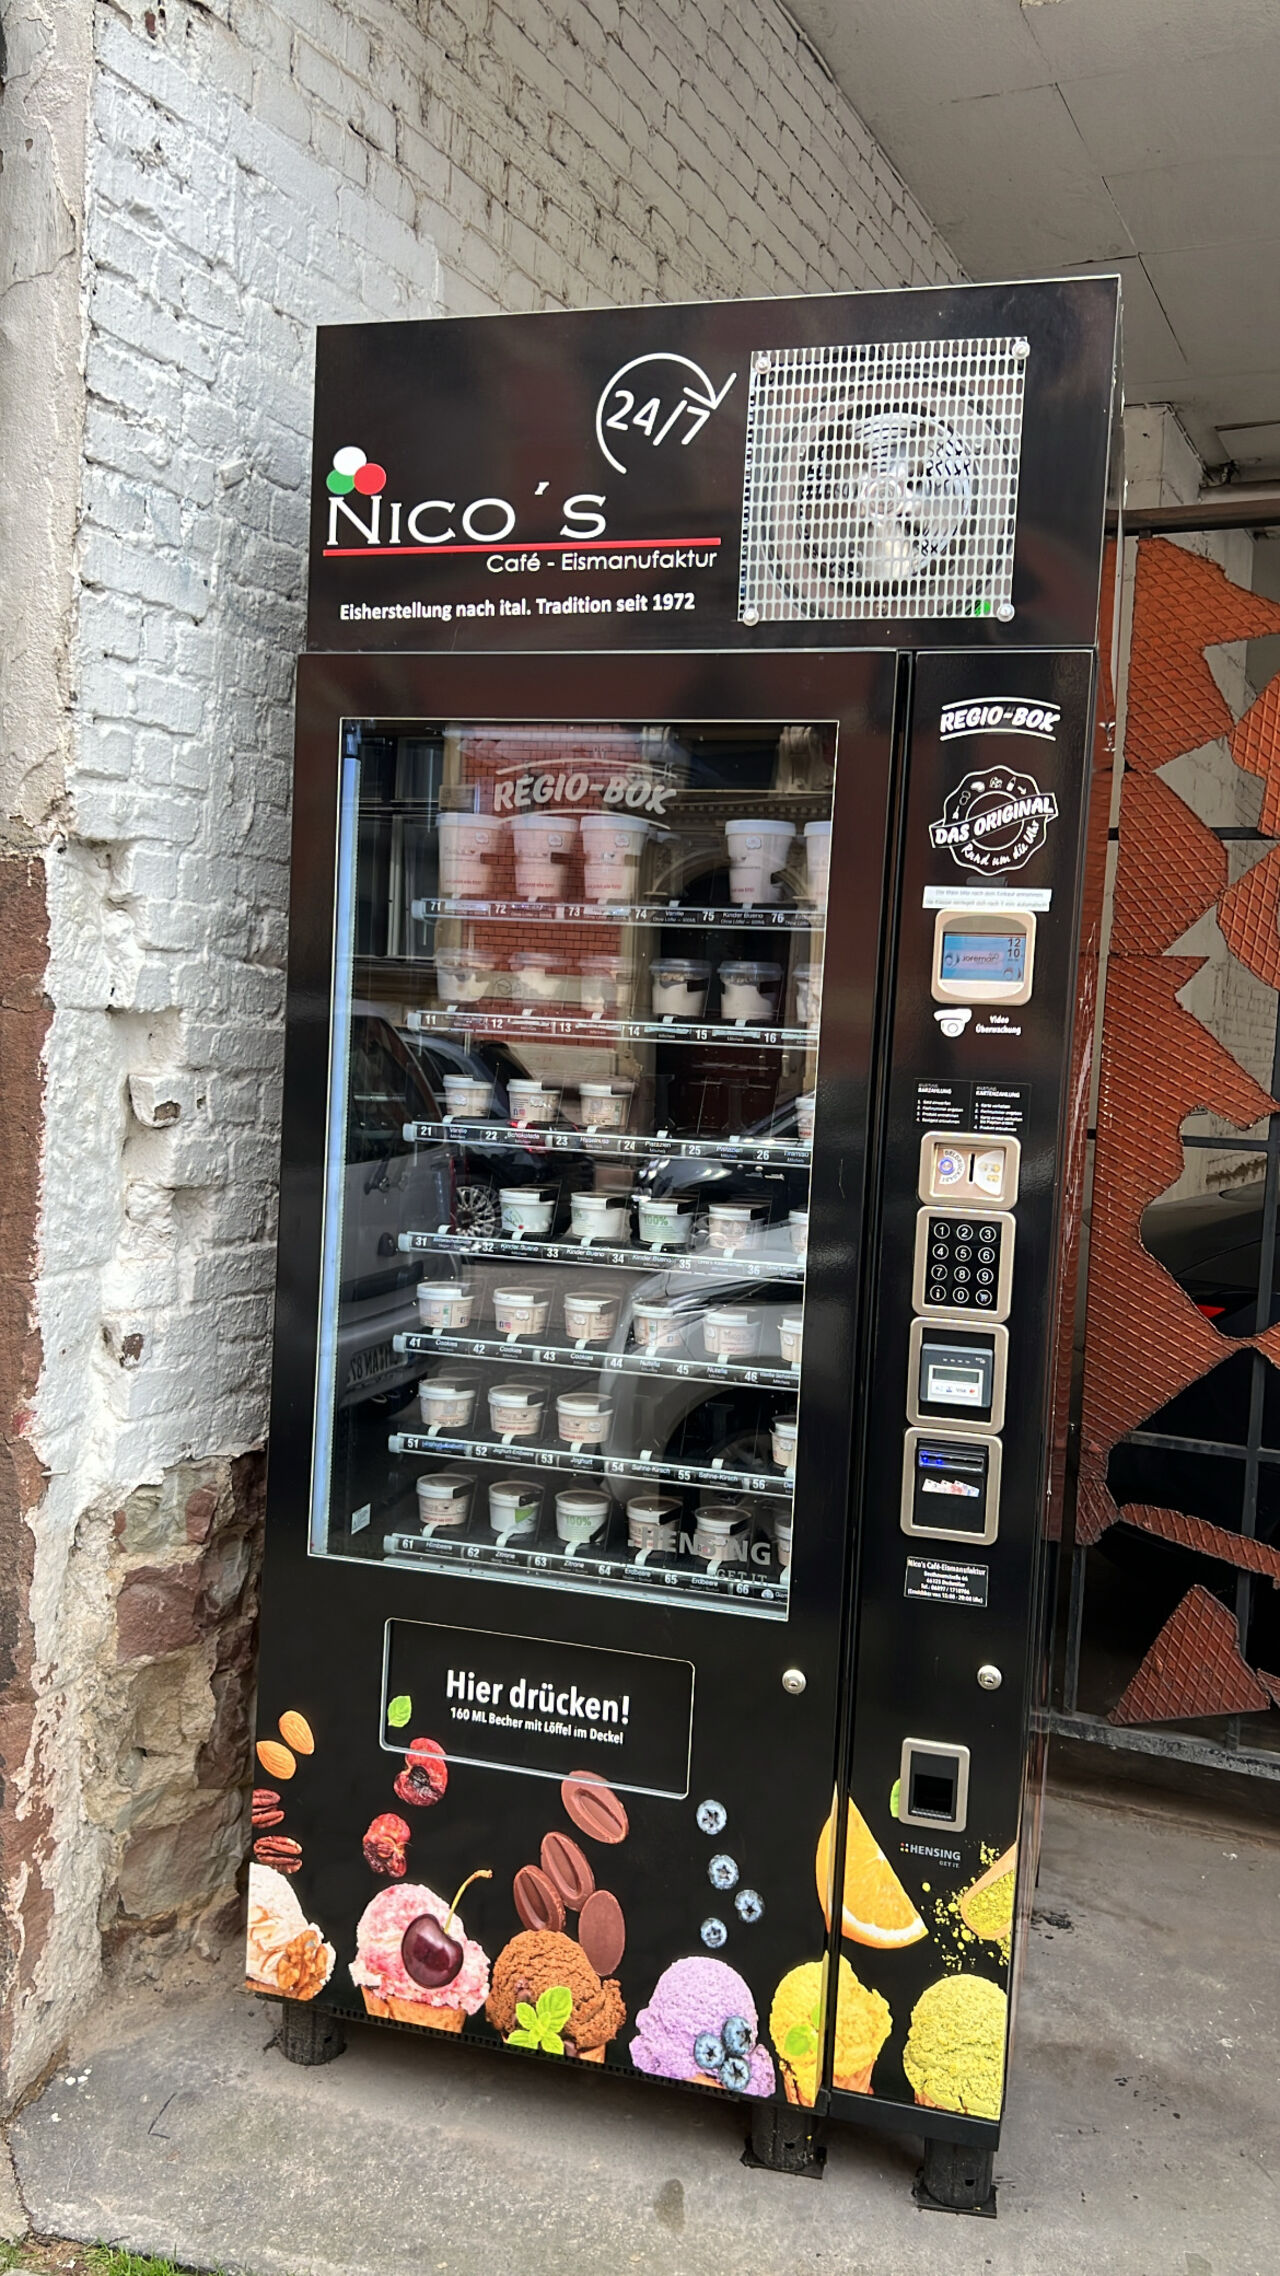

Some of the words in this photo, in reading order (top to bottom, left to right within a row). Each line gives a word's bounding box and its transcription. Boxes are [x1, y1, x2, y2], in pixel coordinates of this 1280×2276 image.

[606, 390, 710, 445] 24/7
[487, 553, 541, 573] Café
[561, 550, 717, 571] Eismanufaktur
[340, 602, 452, 622] Eisherstellung
[456, 600, 495, 617] nach
[500, 598, 532, 616] ital.
[536, 596, 612, 615] Tradition
[616, 594, 648, 612] seit
[652, 592, 695, 611] 1972
[935, 824, 970, 844] DAS
[974, 797, 1054, 836] ORIGINAL
[961, 843, 990, 866] Rund
[992, 856, 1011, 866] um
[1013, 843, 1028, 859] die
[1023, 820, 1040, 844] Uhr
[431, 902, 442, 911] 71
[495, 904, 506, 914] 72
[569, 907, 580, 917] 73
[636, 909, 647, 920] 74
[703, 911, 715, 922] 75
[772, 913, 784, 924] 76
[1008, 939, 1021, 947] 12
[1008, 949, 1020, 958] 10
[425, 1015, 436, 1025] 11
[492, 1019, 503, 1029] 12
[990, 1016, 1010, 1024] Video
[560, 1023, 572, 1033] 13
[628, 1026, 640, 1037] 14
[976, 1024, 1022, 1035] Überwachung
[696, 1030, 708, 1040] 15
[764, 1032, 777, 1043] 16
[421, 1126, 432, 1136] 21
[486, 1131, 498, 1141] 22
[556, 1136, 568, 1146] 23
[624, 1141, 636, 1150] 24
[689, 1145, 701, 1156] 25
[757, 1150, 770, 1161] 26
[644, 1214, 668, 1226] 100%
[940, 1226, 944, 1236] 1
[962, 1228, 968, 1238] 2
[984, 1230, 991, 1240] 3
[416, 1237, 427, 1247] 31
[483, 1242, 494, 1252] 32
[547, 1248, 559, 1258] 33
[937, 1247, 944, 1256] 4
[960, 1249, 967, 1258] 5
[983, 1251, 990, 1260] 6
[612, 1254, 624, 1264] 34
[679, 1259, 691, 1269] 35
[748, 1265, 760, 1276] 36
[936, 1268, 943, 1277] 7
[959, 1270, 966, 1279] 8
[982, 1272, 988, 1281] 9
[958, 1291, 964, 1300] 0
[409, 1338, 421, 1348] 41
[473, 1344, 485, 1354] 42
[500, 1346, 522, 1354] Cookies
[543, 1351, 556, 1361] 43
[570, 1353, 594, 1361] Cookies
[610, 1358, 623, 1368] 44
[677, 1365, 689, 1375] 45
[745, 1371, 758, 1382] 46
[408, 1439, 419, 1449] 51
[476, 1446, 488, 1456] 52
[541, 1454, 553, 1464] 53
[570, 1457, 593, 1465] Joghurt
[612, 1463, 624, 1472] 54
[632, 1464, 671, 1474] Sahne-Kirsch
[678, 1470, 691, 1480] 55
[699, 1472, 738, 1482] Sahne-Kirsch
[753, 1479, 766, 1489] 56
[566, 1516, 591, 1526] 100%
[402, 1539, 414, 1549] 61
[468, 1548, 480, 1558] 62
[535, 1556, 547, 1566] 63
[564, 1560, 585, 1569] Zitrone
[599, 1565, 612, 1576] 64
[624, 1568, 652, 1578] Erdbeere
[908, 1560, 926, 1569] Nico's
[927, 1562, 986, 1576] Café-Eismanufaktur
[717, 1569, 747, 1582] GET
[665, 1575, 677, 1584] 65
[692, 1577, 719, 1587] Erdbeere
[736, 1584, 749, 1594] 66
[446, 1670, 503, 1705] Hier
[509, 1678, 630, 1725] drücken!
[450, 1707, 470, 1721] 160
[472, 1710, 487, 1724] ML
[489, 1712, 524, 1729] Becher
[525, 1719, 542, 1732] mit
[544, 1721, 572, 1736] Löffel
[574, 1726, 587, 1739] im
[590, 1728, 624, 1745] Deckel
[910, 1844, 961, 1861] HENSING
